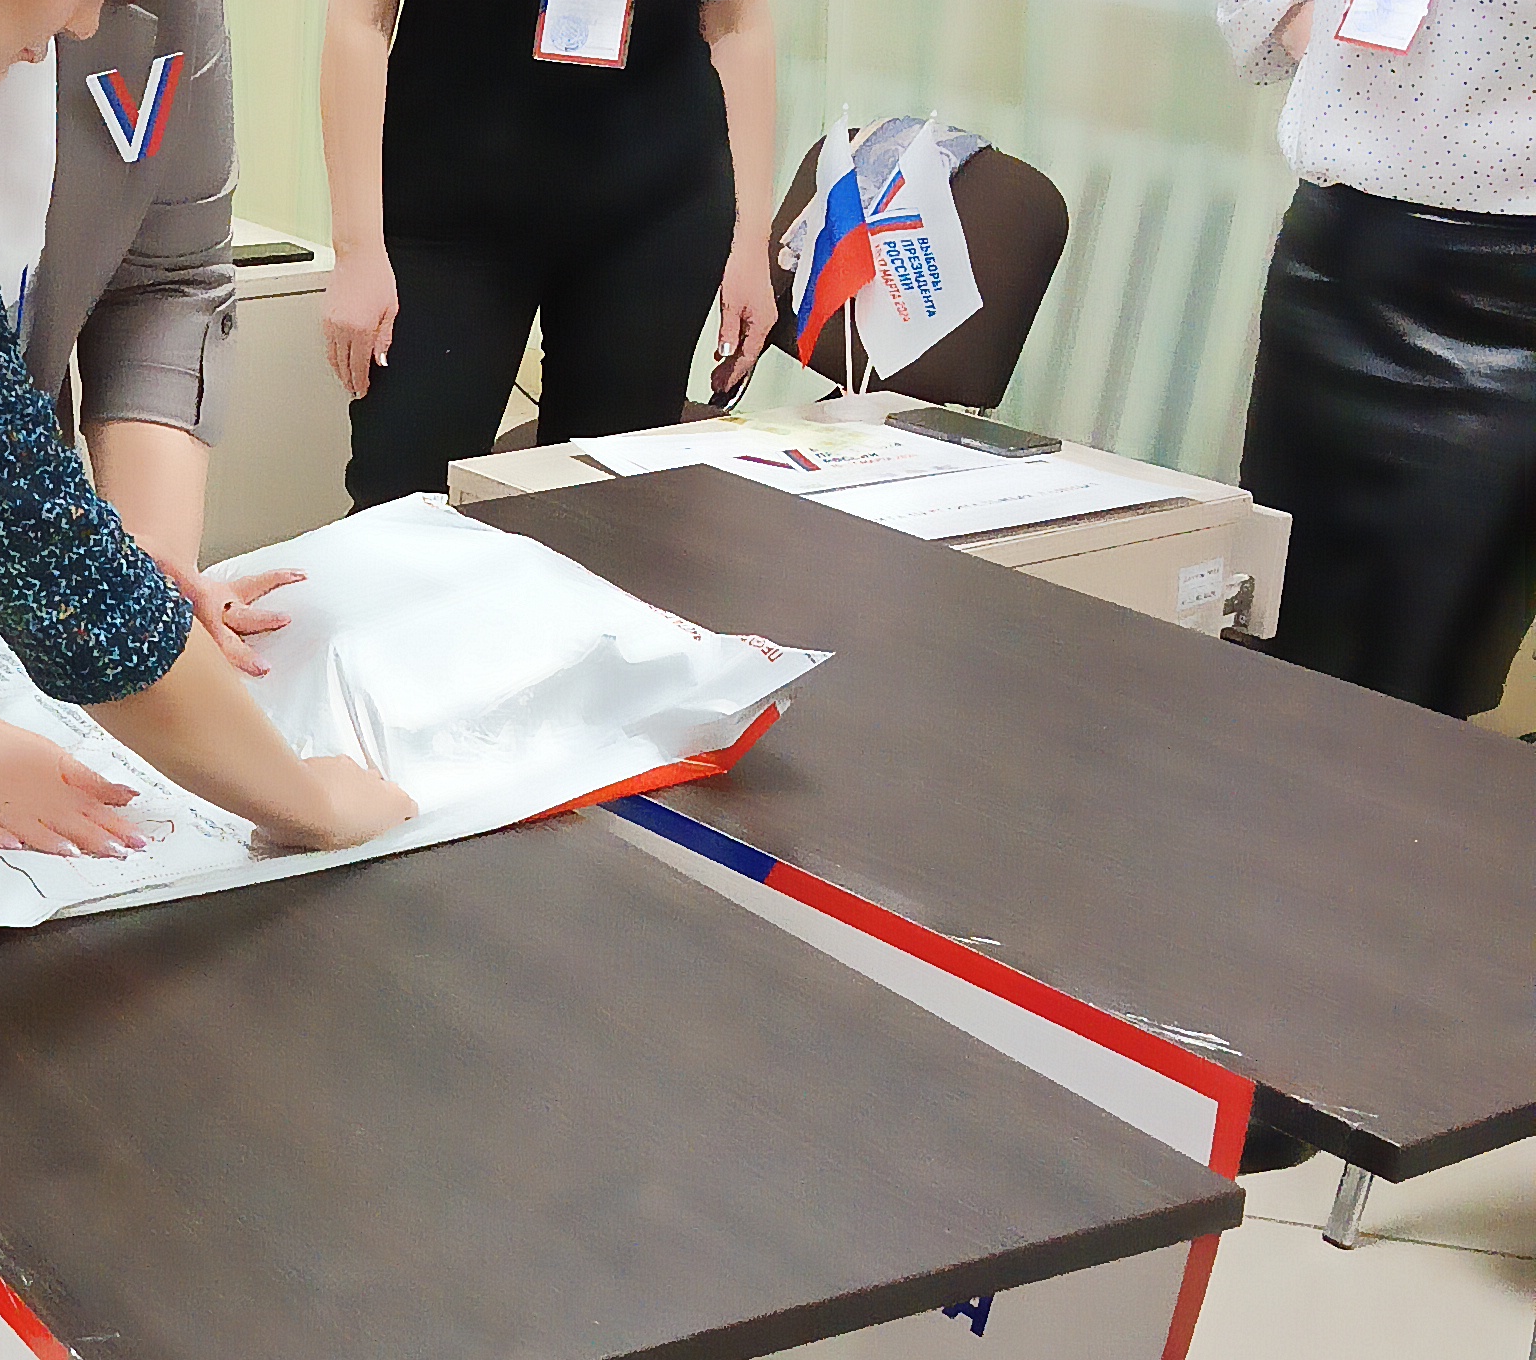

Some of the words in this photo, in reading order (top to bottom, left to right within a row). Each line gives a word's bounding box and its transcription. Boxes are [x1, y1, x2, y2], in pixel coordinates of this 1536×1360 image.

[883, 240, 915, 291] РОССИИ
[900, 239, 937, 318] ПРЕЗИДЕНТА
[917, 237, 943, 291] ВЫБОРЫ
